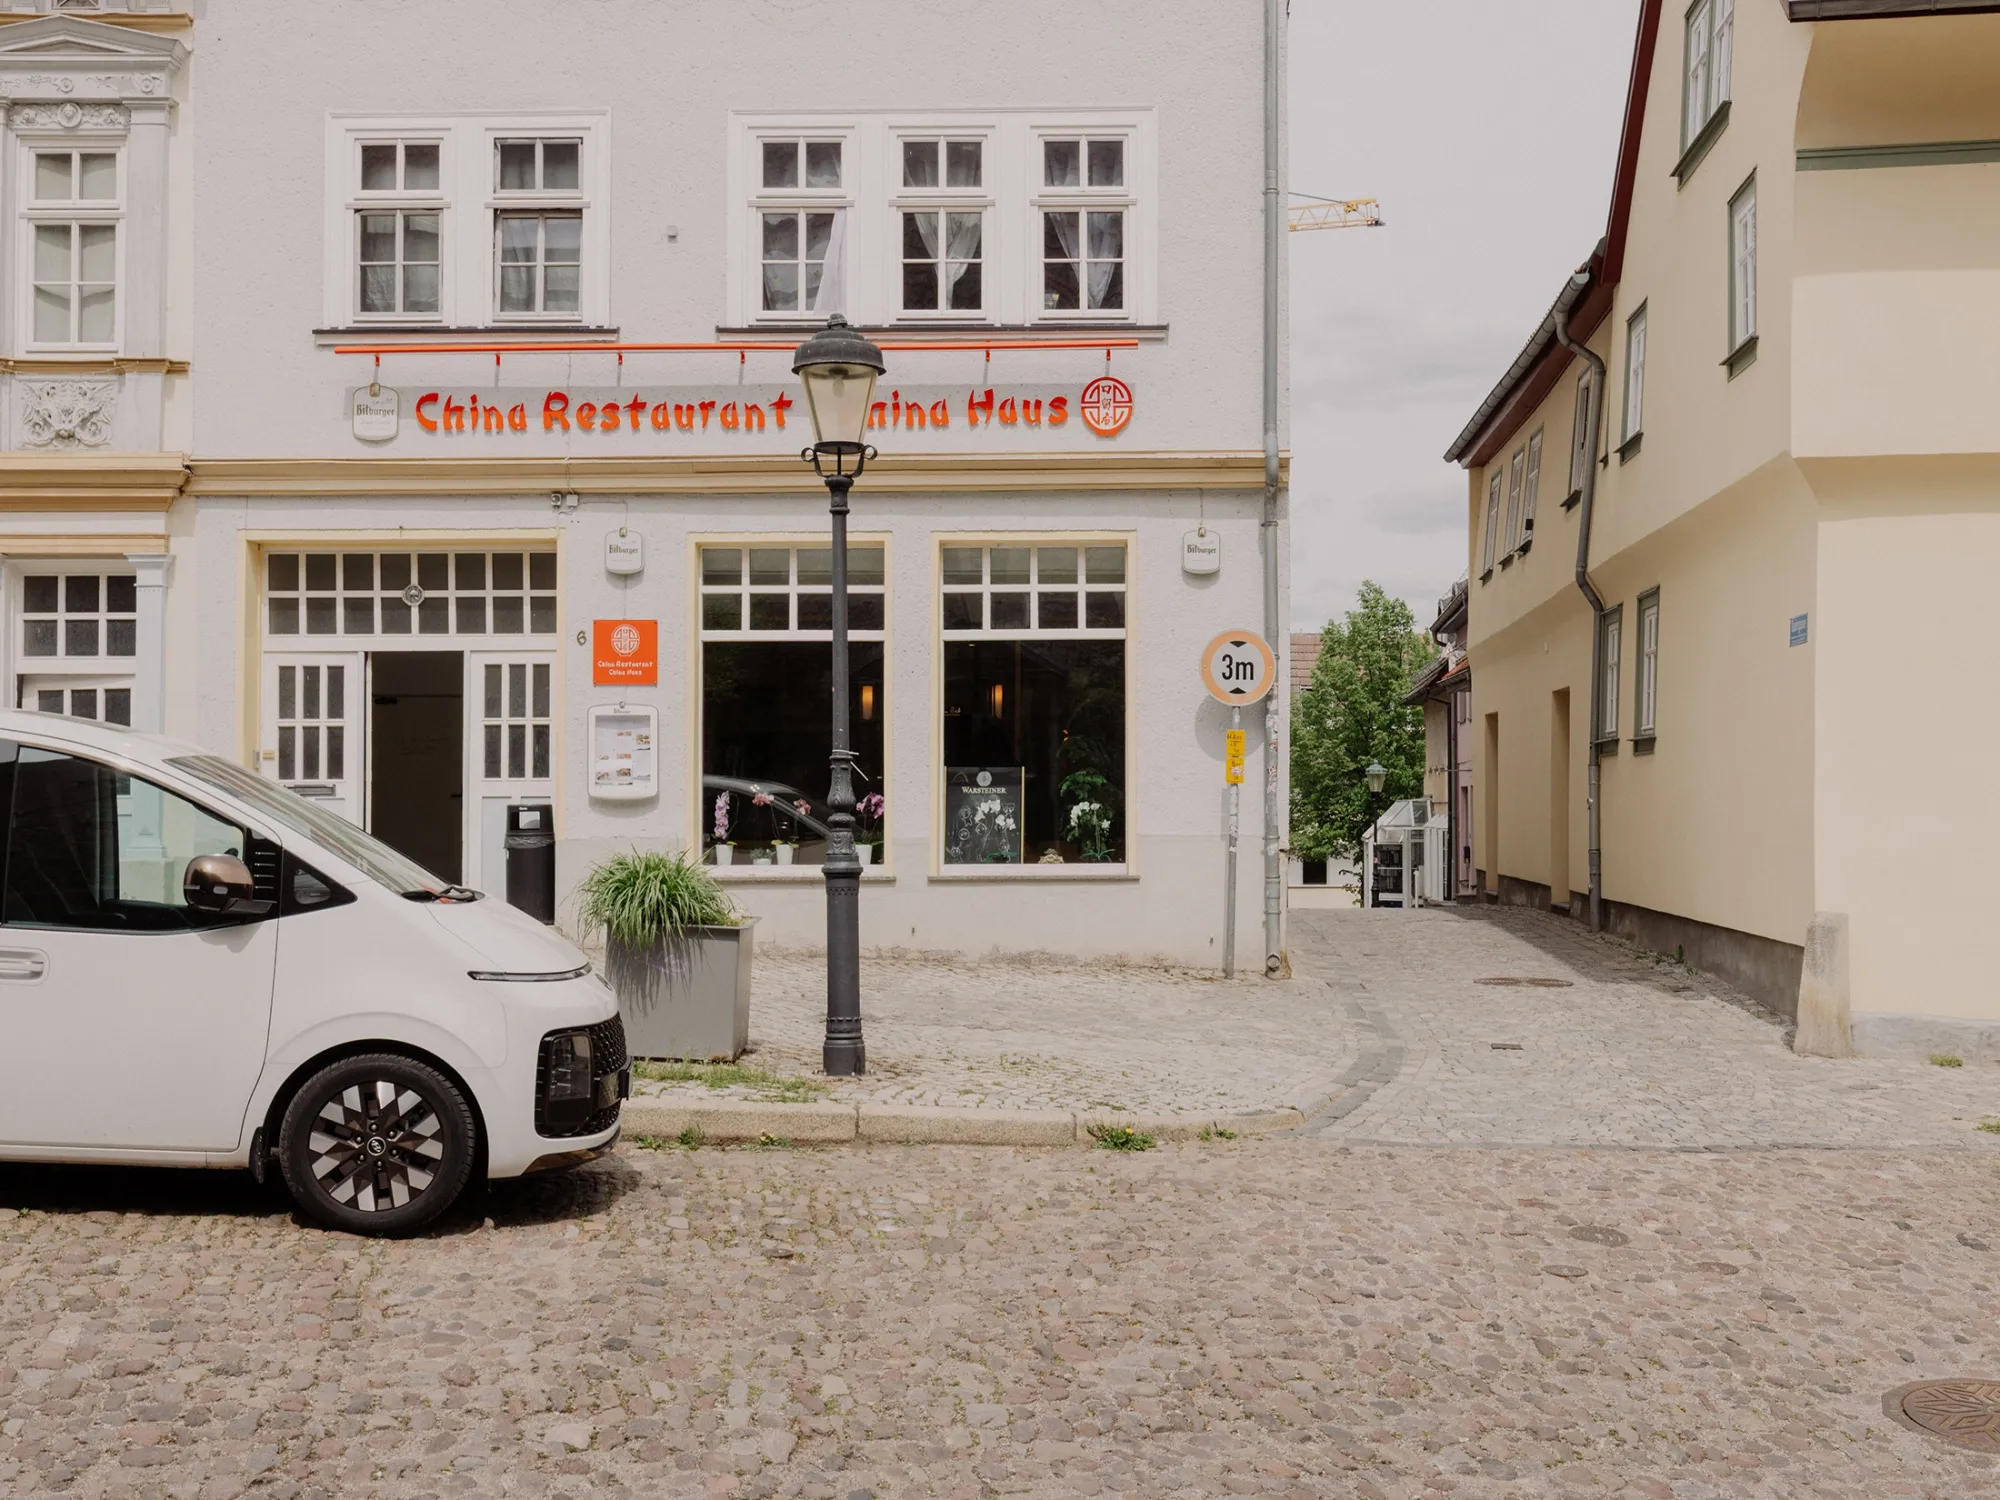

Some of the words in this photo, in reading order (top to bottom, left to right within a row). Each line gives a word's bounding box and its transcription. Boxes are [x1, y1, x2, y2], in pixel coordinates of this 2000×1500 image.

[356, 404, 395, 417] Bitburger
[416, 391, 527, 431] China
[543, 390, 794, 431] Restaurant
[969, 388, 1068, 426] Haus
[609, 544, 639, 555] Bitburger
[1187, 544, 1217, 555] Bitburger
[576, 630, 588, 647] 6
[1221, 654, 1254, 681] 3m
